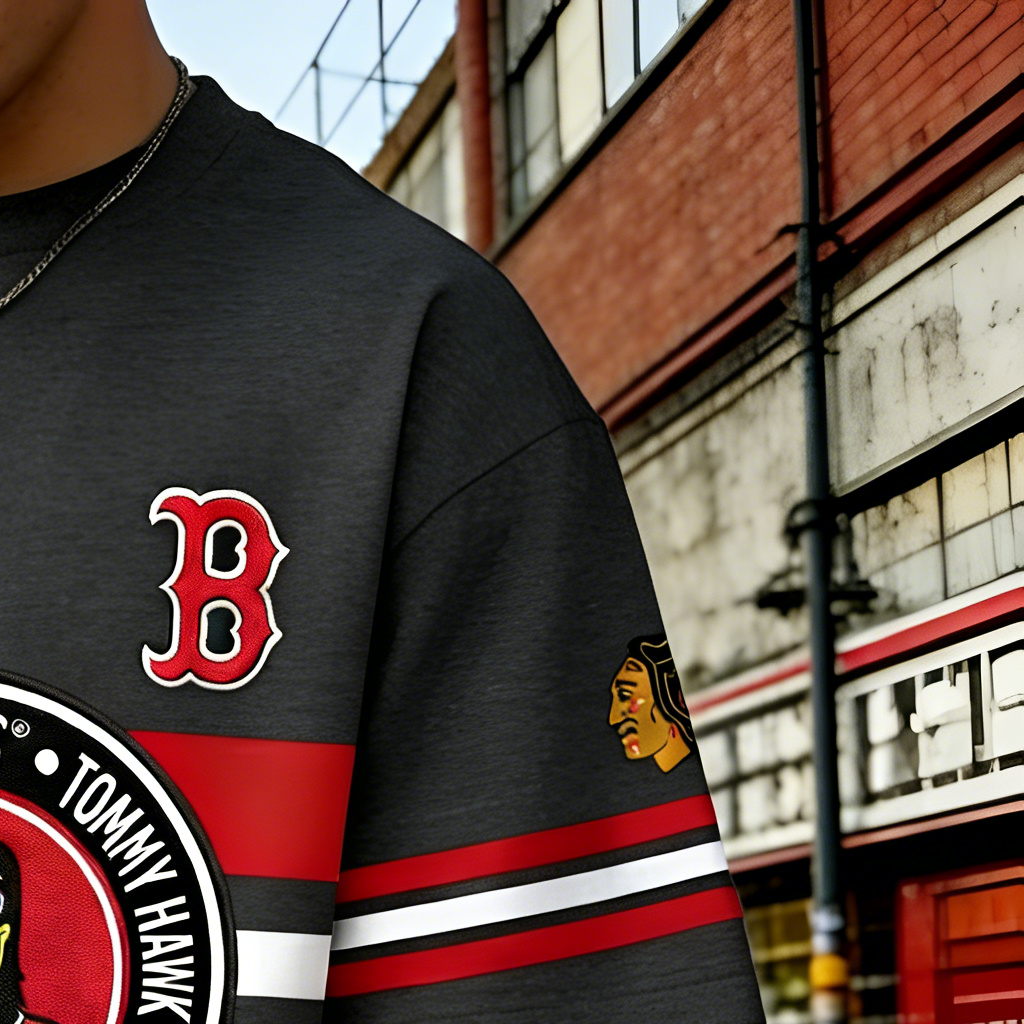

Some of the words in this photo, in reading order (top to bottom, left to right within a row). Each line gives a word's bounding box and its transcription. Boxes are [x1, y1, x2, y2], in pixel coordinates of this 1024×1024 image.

[141, 486, 290, 691] B
[59, 753, 178, 893] TOMMY
[134, 896, 195, 1024] HAWK
